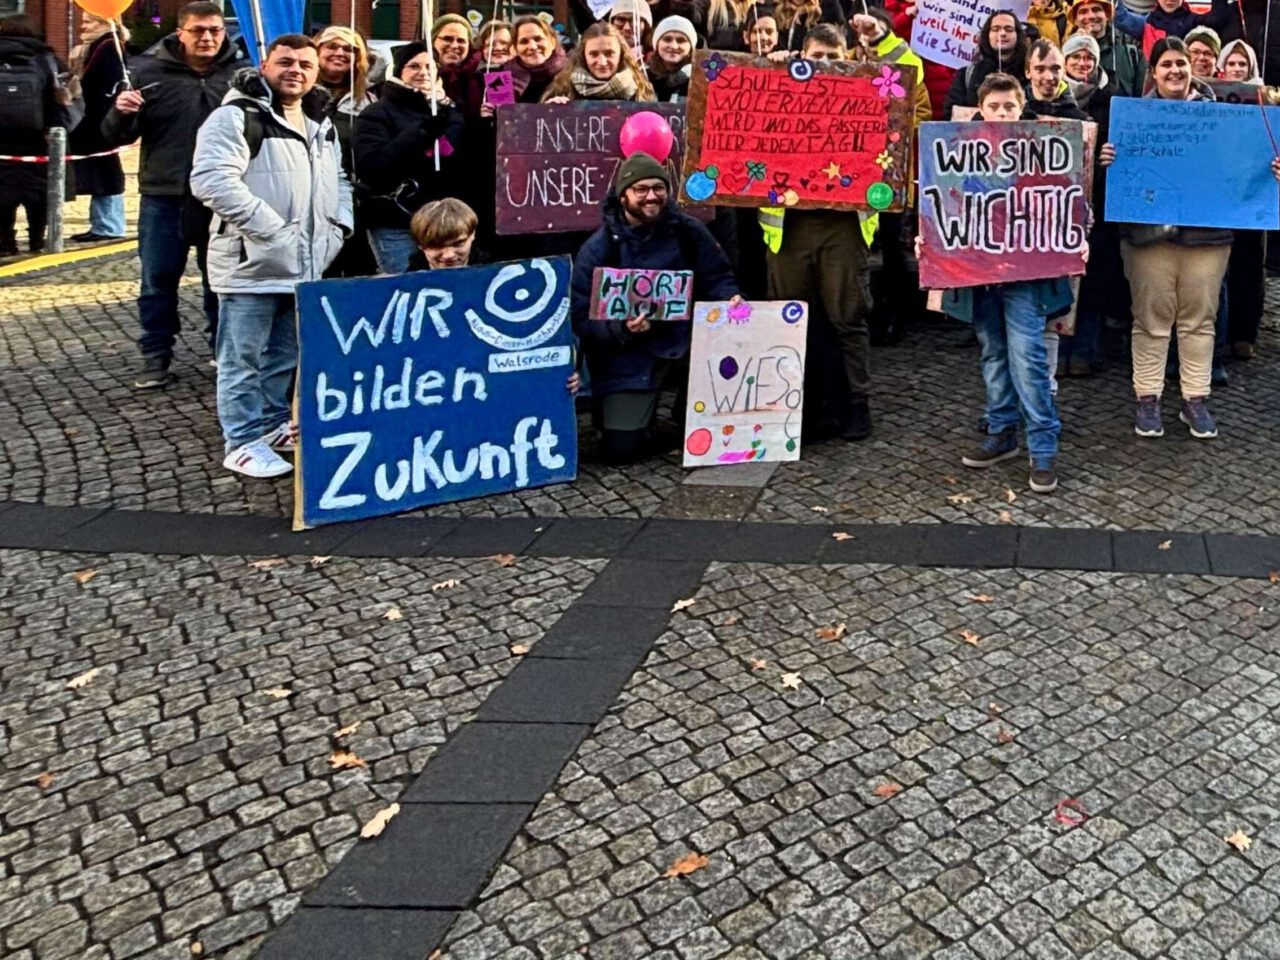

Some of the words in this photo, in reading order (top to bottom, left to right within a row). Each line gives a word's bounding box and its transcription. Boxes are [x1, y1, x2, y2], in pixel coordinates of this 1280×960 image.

[923, 1, 945, 14] wir
[949, 10, 974, 27] sind
[952, 24, 970, 41] ihr
[917, 31, 939, 49] die
[933, 137, 992, 176] WIR
[995, 134, 1073, 177] SIND
[506, 166, 600, 208] UNSERE
[922, 185, 1085, 254] WICHTIG
[320, 287, 453, 356] WIR
[494, 351, 560, 369] Walsrode
[316, 357, 488, 422] bilden
